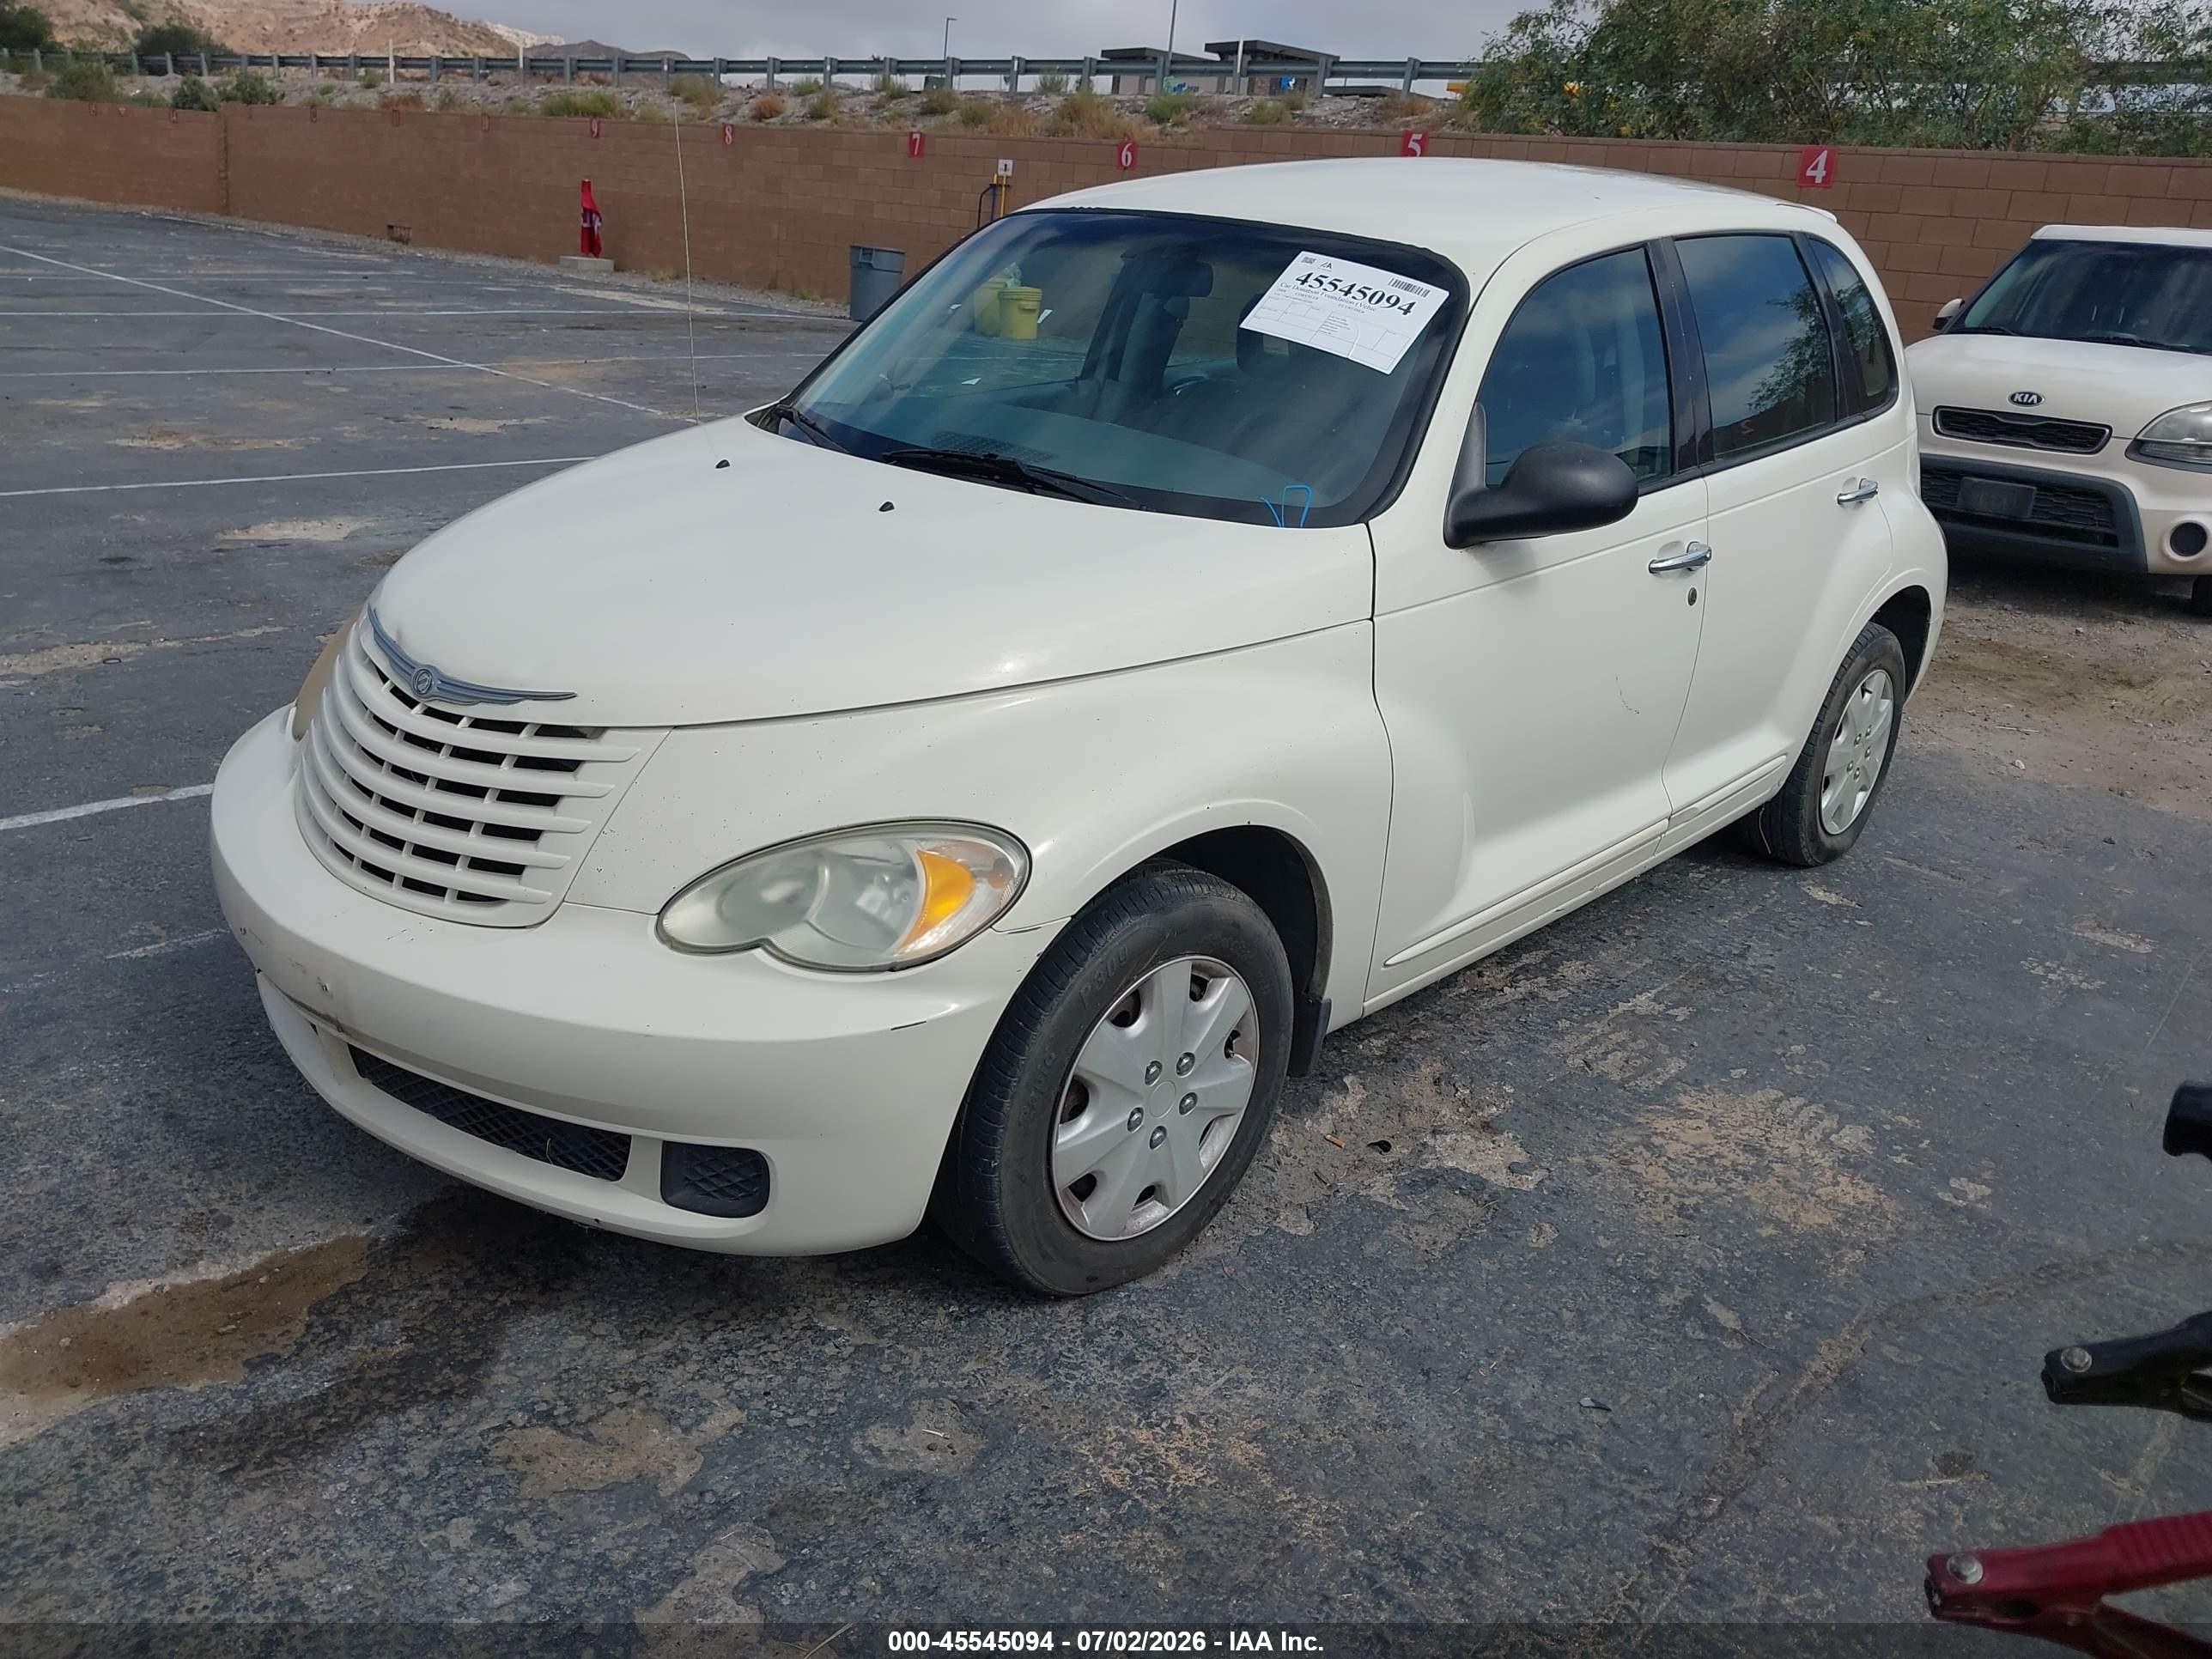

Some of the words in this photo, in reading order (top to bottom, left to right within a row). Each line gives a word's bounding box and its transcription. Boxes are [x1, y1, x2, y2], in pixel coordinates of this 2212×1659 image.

[592, 118, 599, 137] 9
[725, 125, 732, 145] 8
[912, 133, 921, 155] 7
[1121, 143, 1133, 167] 6
[1407, 133, 1423, 157] 5
[1805, 149, 1828, 184] 4
[1295, 271, 1418, 316] 45545094
[2013, 392, 2039, 404] KIA
